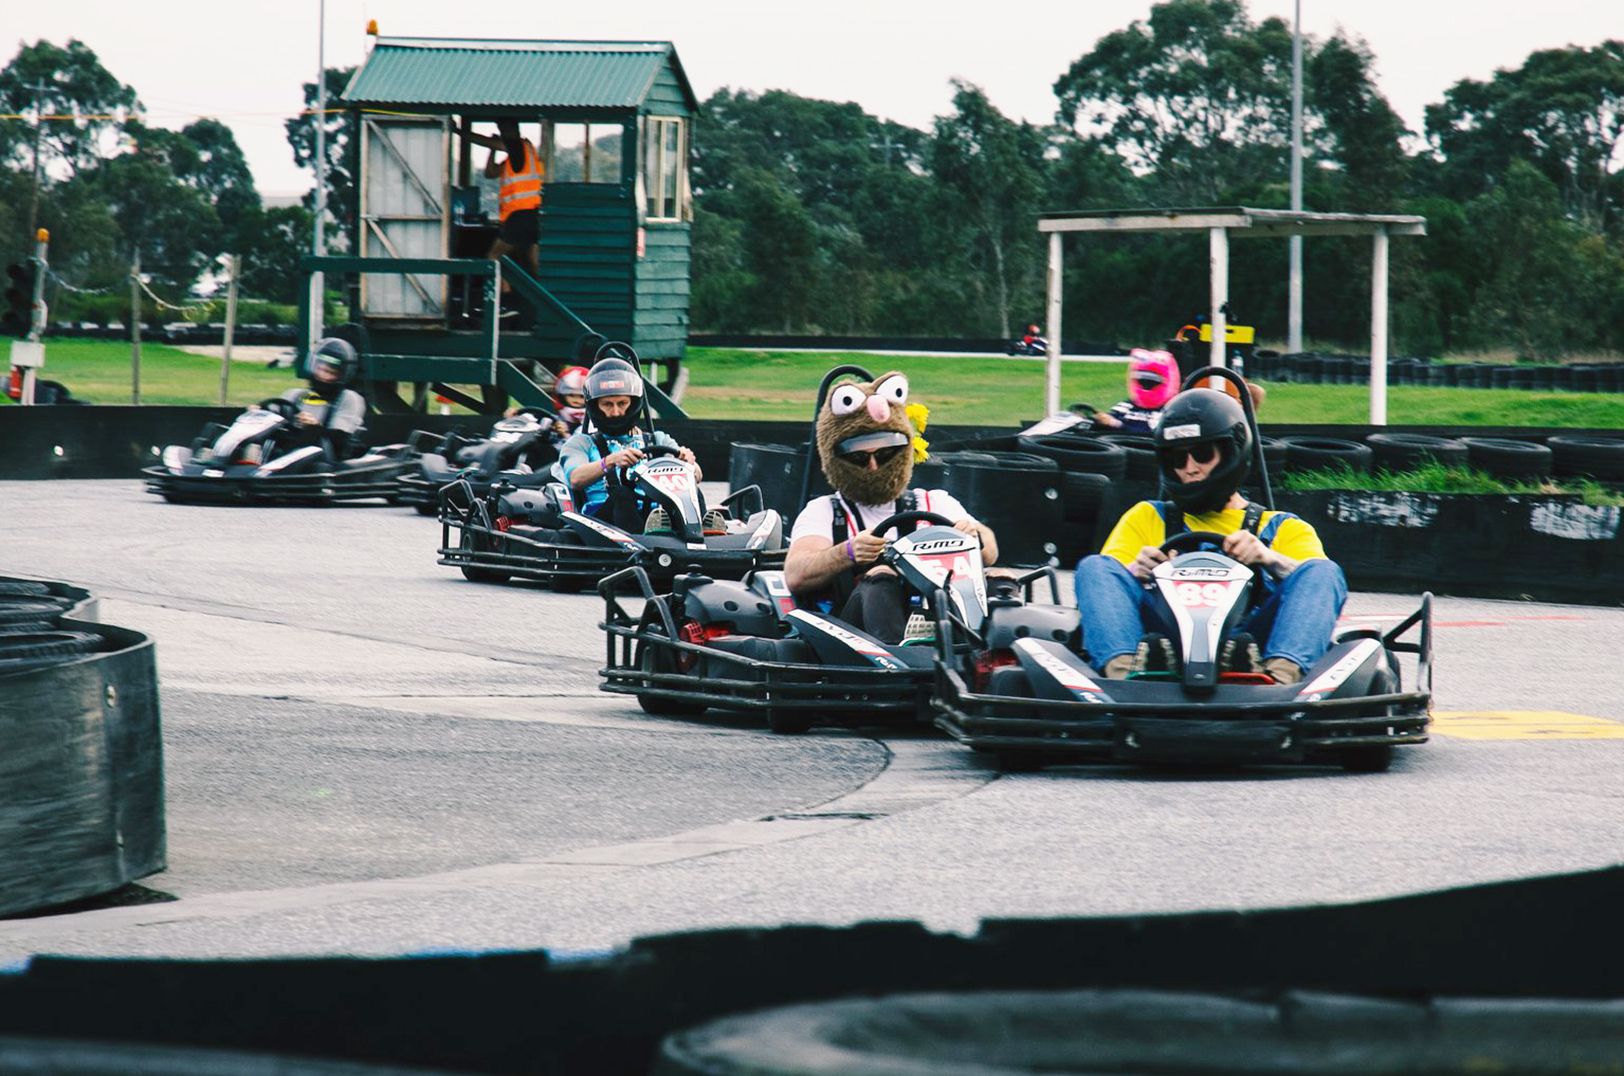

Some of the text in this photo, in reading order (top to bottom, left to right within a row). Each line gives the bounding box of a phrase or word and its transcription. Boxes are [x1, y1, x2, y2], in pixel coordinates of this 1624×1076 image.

[656, 475, 689, 491] 40
[919, 556, 974, 580] 54
[1175, 583, 1228, 606] 89
